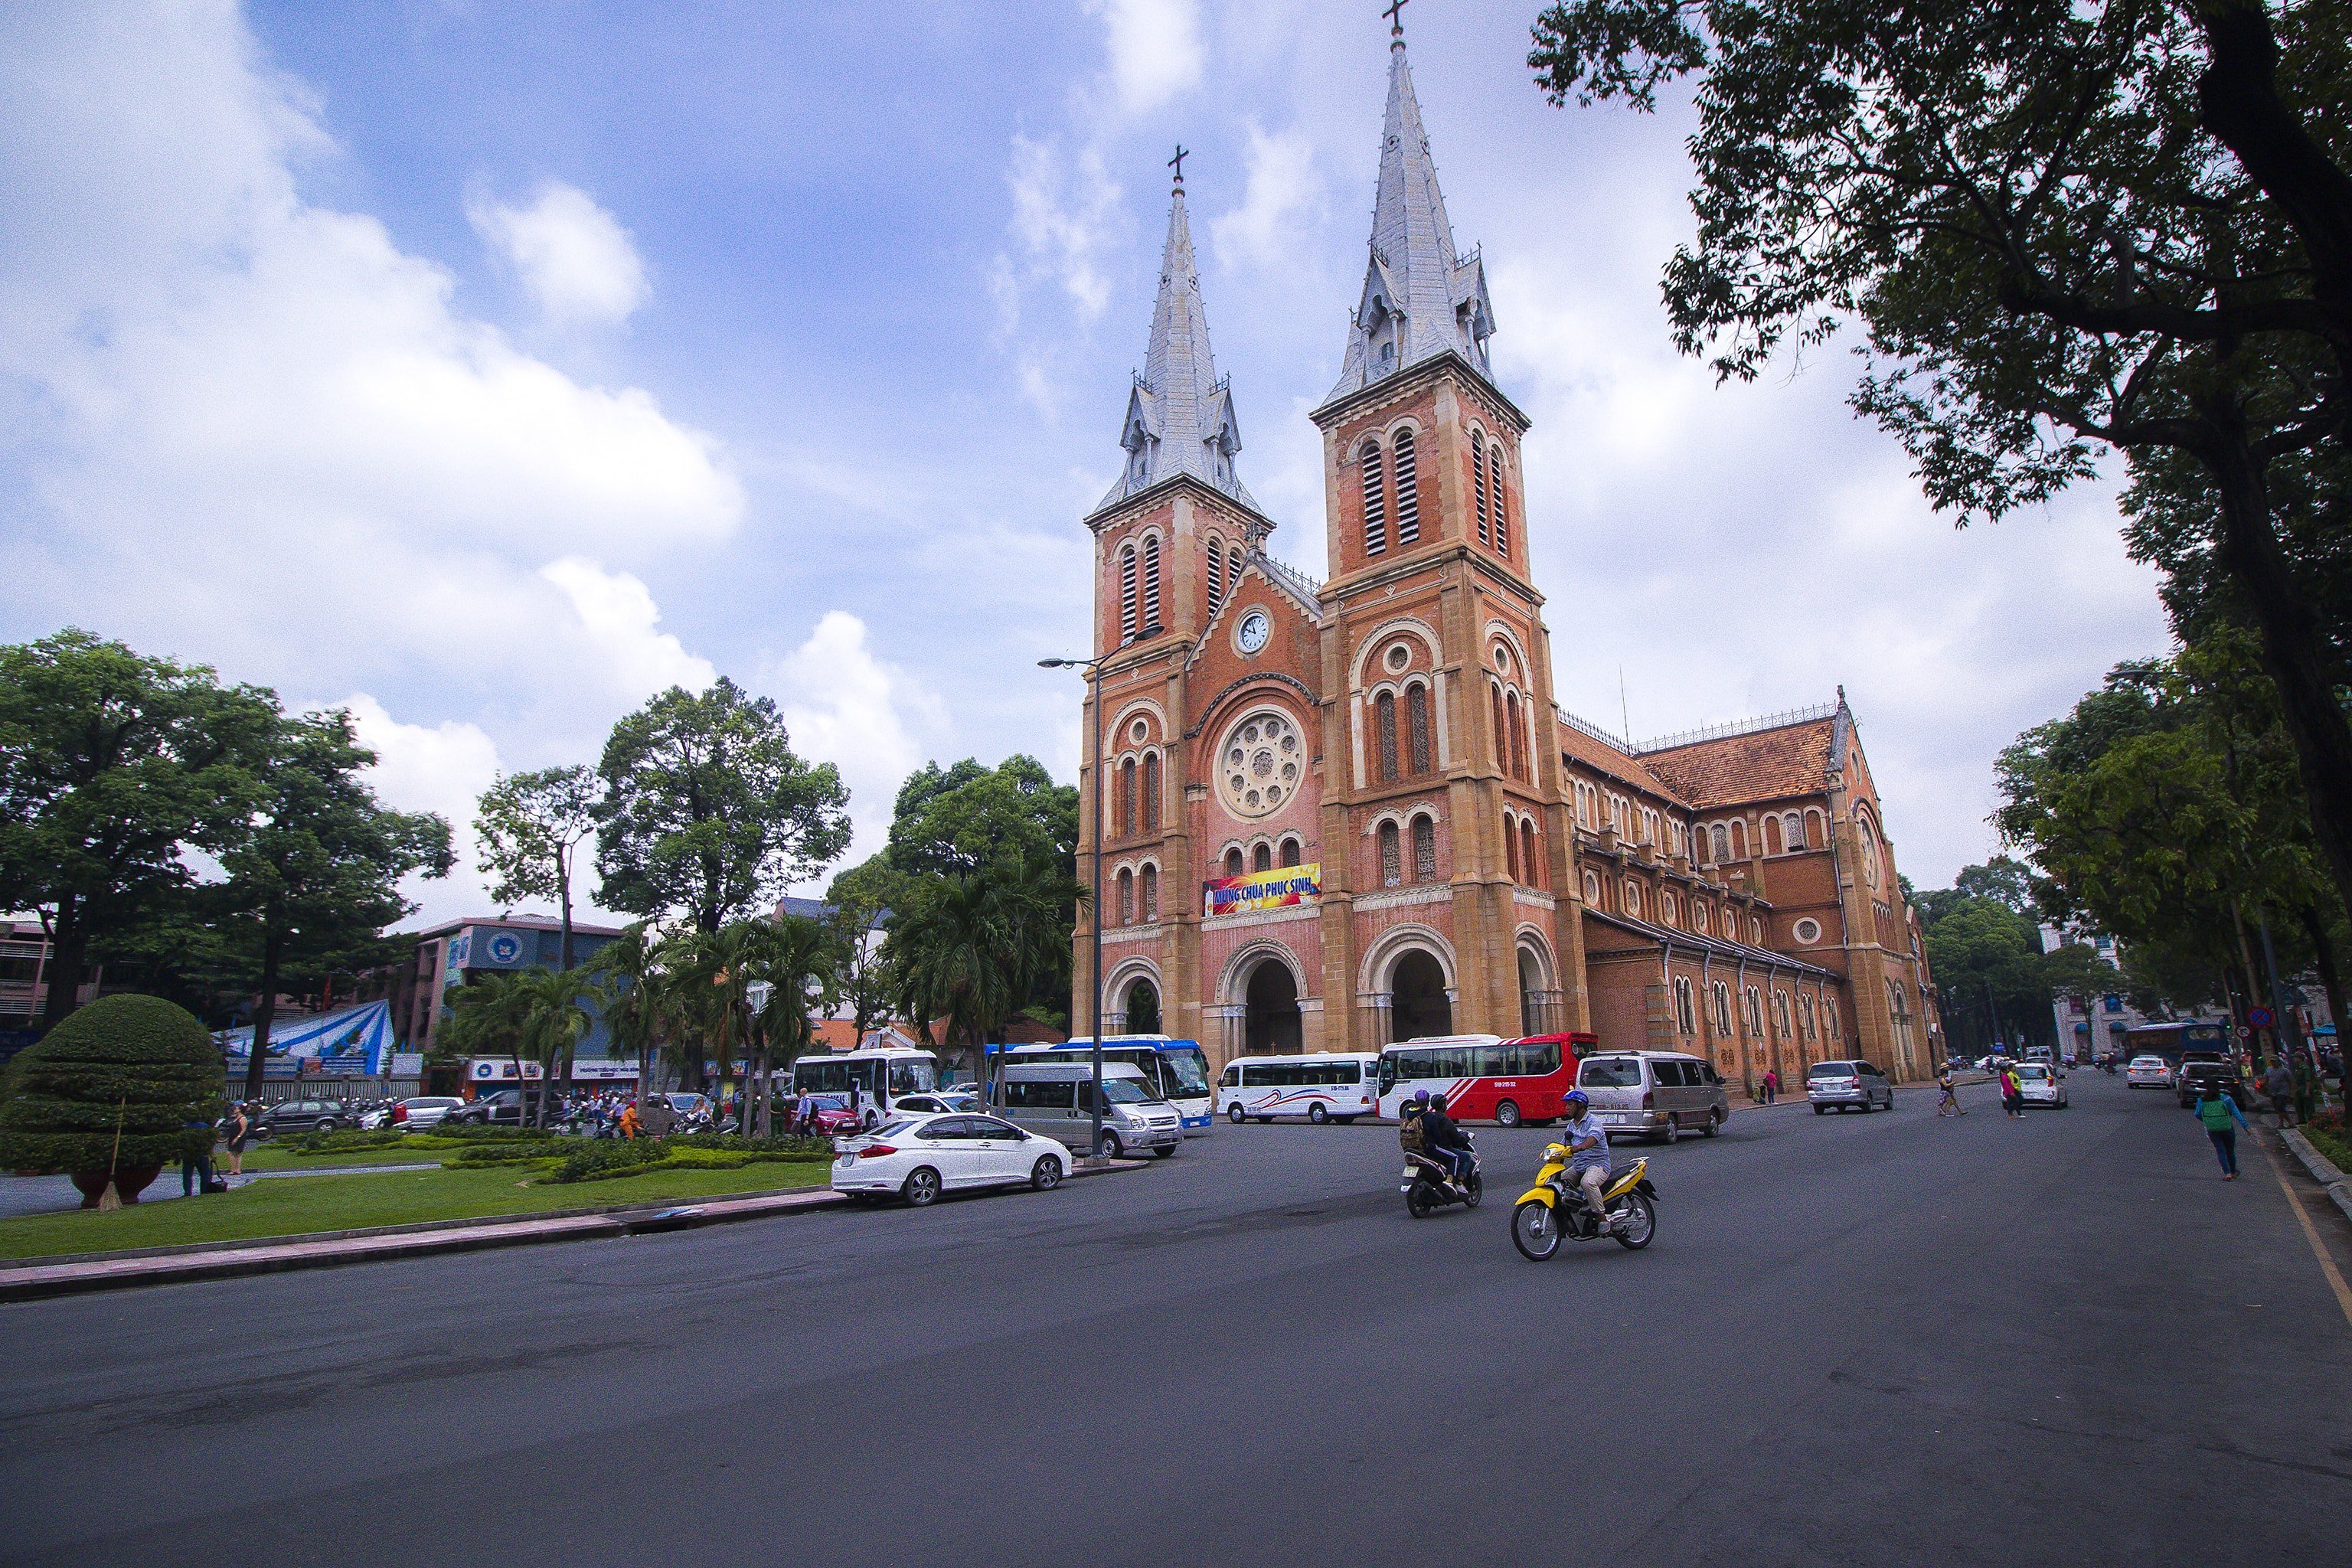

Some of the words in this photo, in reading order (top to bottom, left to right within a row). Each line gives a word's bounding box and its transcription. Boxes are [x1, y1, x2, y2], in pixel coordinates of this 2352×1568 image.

[1214, 886, 1240, 904] MỪNG
[1241, 882, 1263, 900] CHÚA
[1266, 880, 1289, 899] PHỤC
[1290, 877, 1312, 893] SINH
